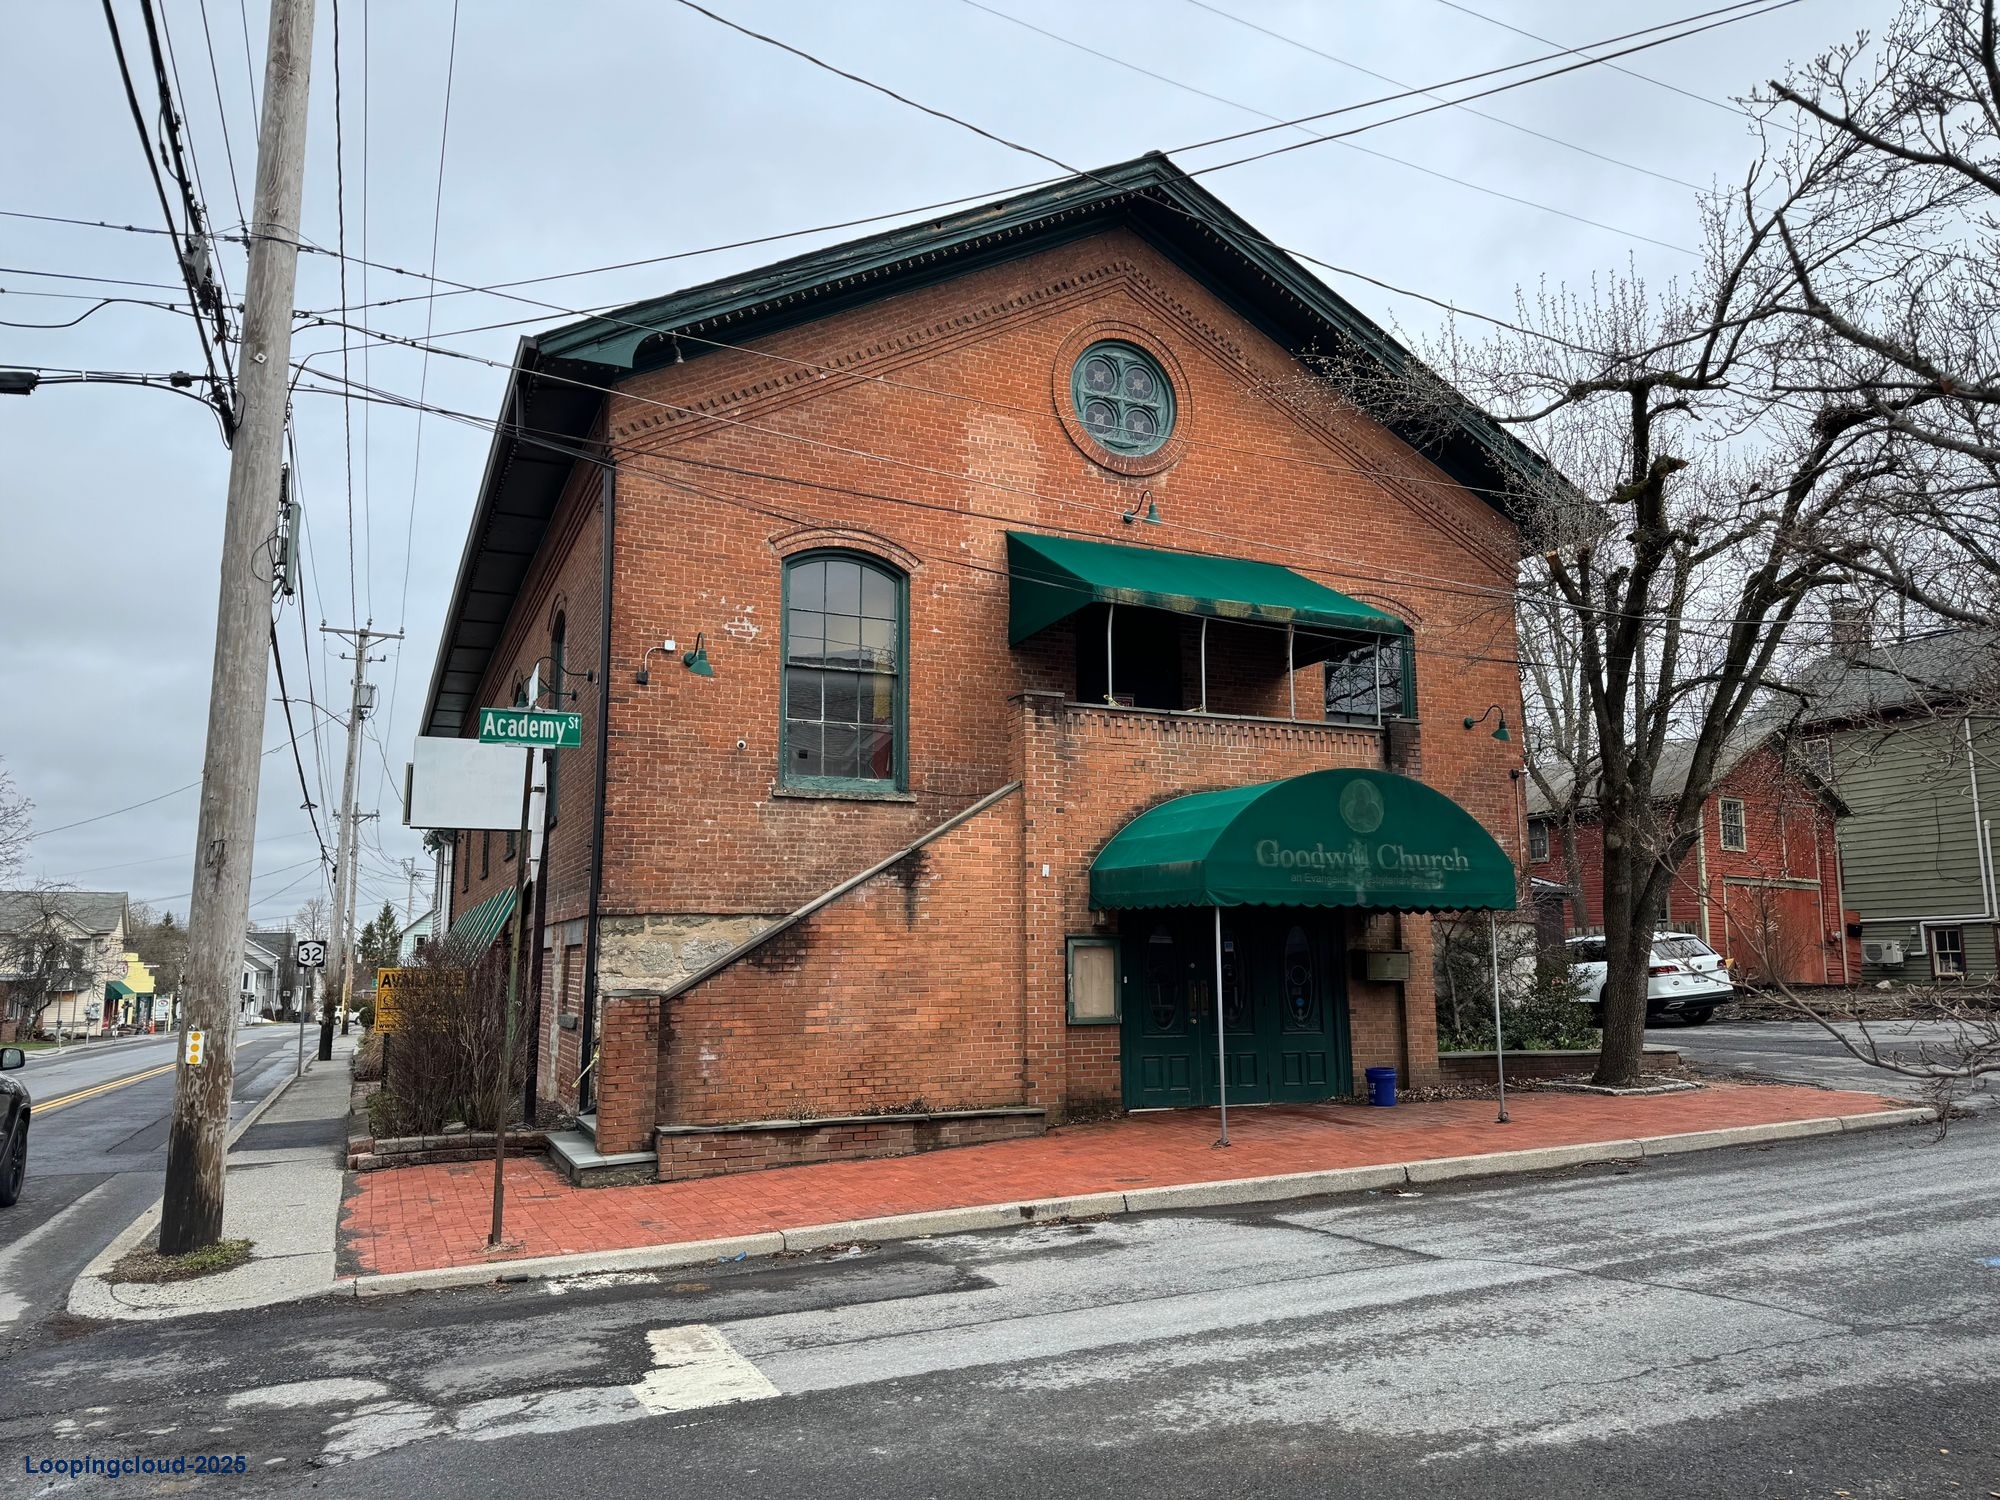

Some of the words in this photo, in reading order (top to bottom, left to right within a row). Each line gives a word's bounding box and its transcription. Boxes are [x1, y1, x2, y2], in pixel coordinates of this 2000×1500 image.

[482, 712, 566, 745] Academy
[568, 716, 580, 730] St
[1256, 839, 1369, 869] Goodwill
[1377, 844, 1470, 871] Church
[300, 946, 322, 962] 32
